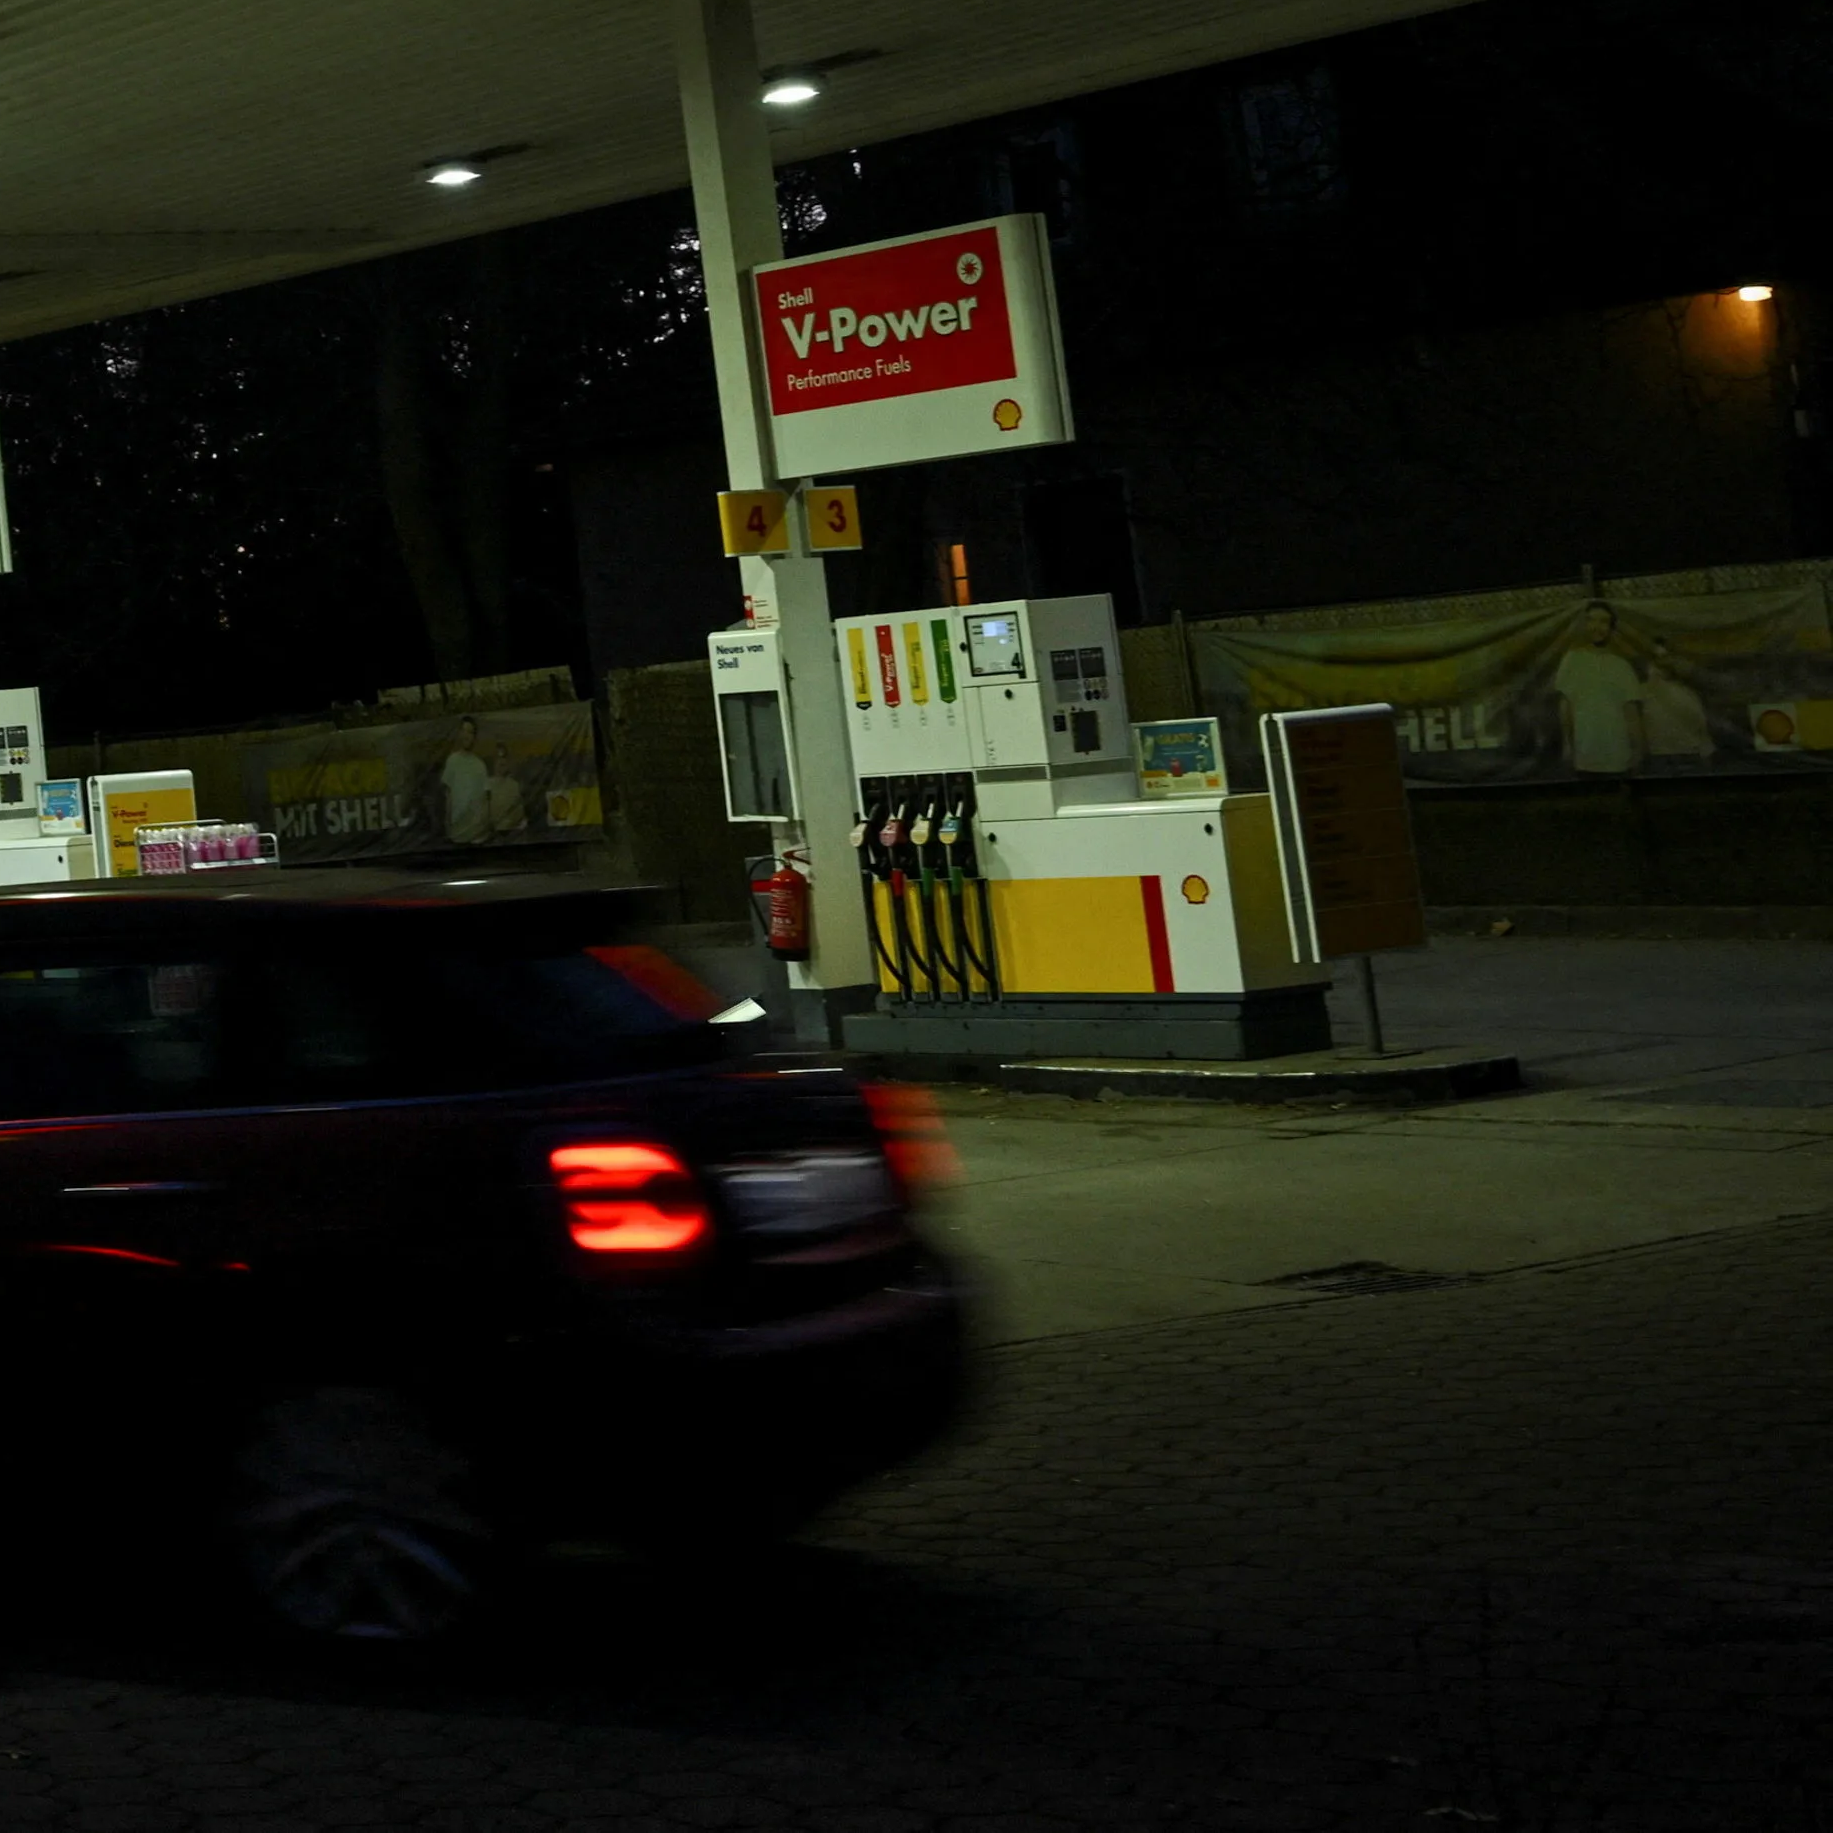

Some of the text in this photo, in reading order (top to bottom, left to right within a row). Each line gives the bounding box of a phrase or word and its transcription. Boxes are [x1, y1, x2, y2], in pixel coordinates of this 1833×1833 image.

[778, 287, 814, 309] Shell
[781, 296, 977, 359] V-Power
[787, 355, 911, 391] Performance Fuels
[747, 505, 767, 537] 4
[827, 499, 846, 533] 3
[716, 644, 764, 655] Neues von
[717, 658, 739, 669] Shell
[1011, 652, 1021, 670] 4
[1396, 704, 1508, 753] HELL
[325, 794, 417, 835] SHELL
